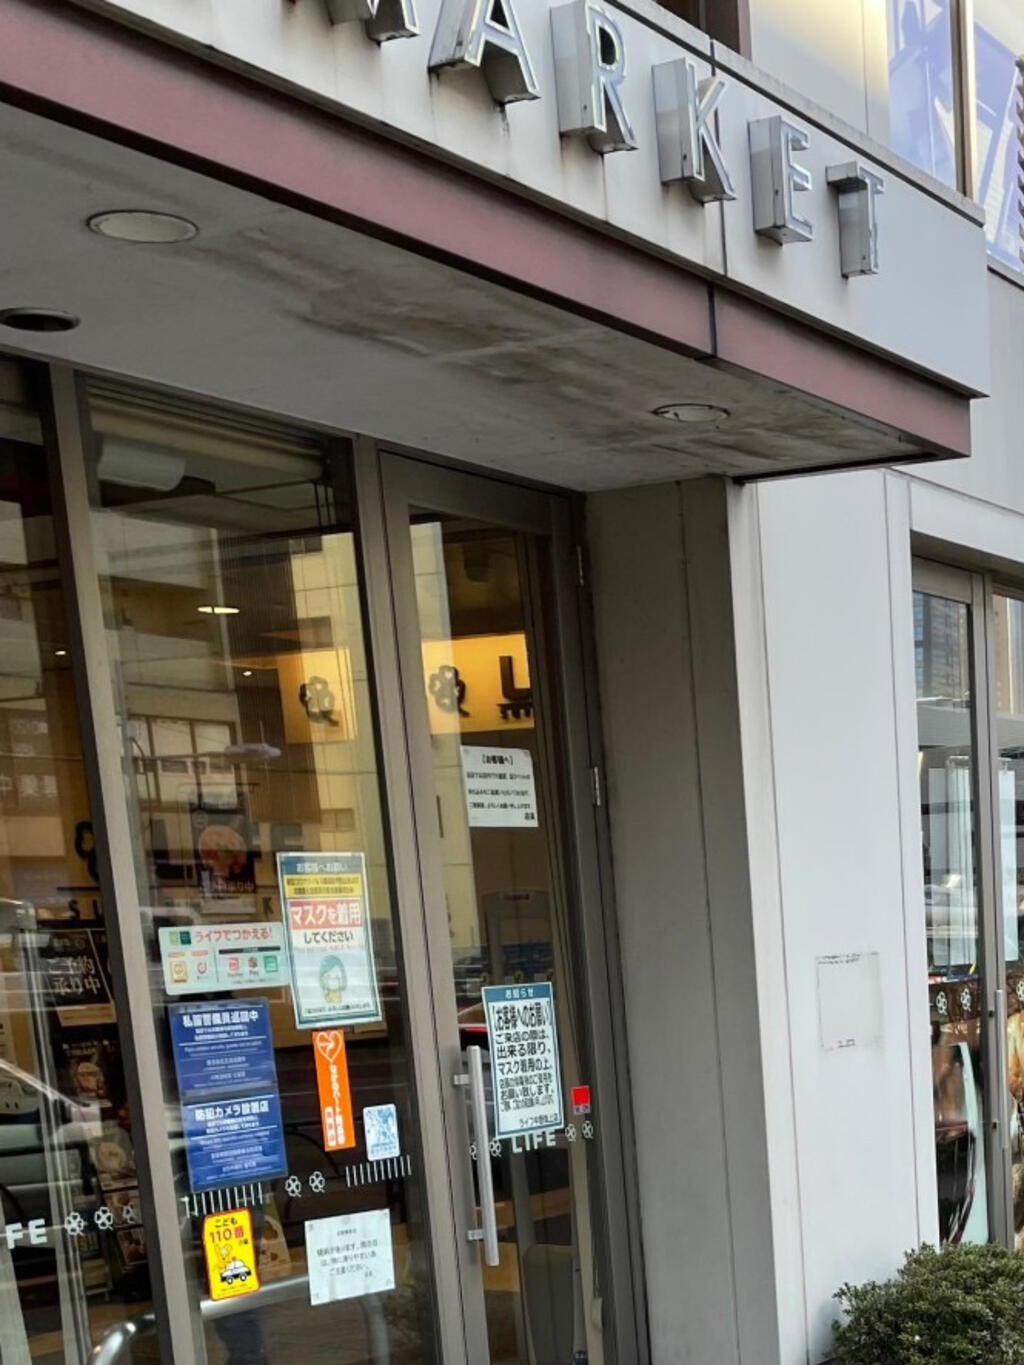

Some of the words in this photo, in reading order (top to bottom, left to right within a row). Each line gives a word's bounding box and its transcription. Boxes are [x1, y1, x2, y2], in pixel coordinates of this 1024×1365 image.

[290, 902, 362, 926] マスクを着用
[304, 931, 354, 944] してください
[505, 987, 534, 999] お知らせ
[497, 1041, 551, 1060] 出来る限り、
[511, 1129, 556, 1154] LIFE
